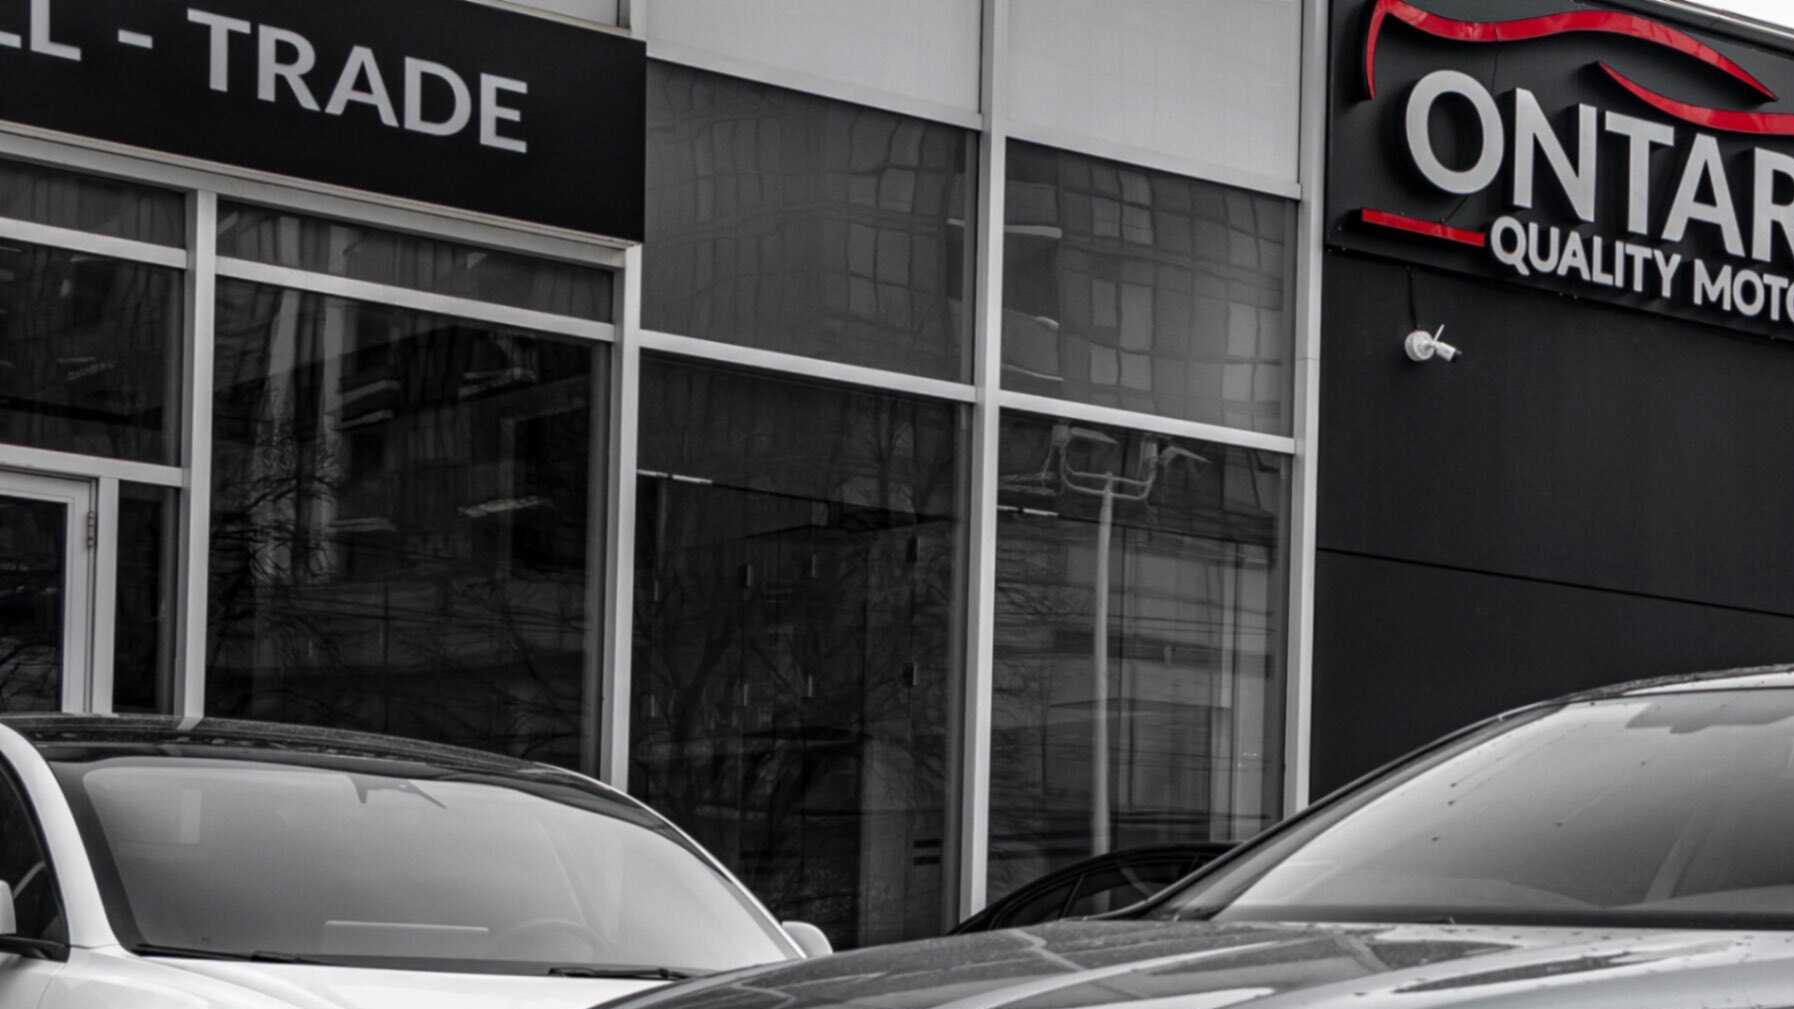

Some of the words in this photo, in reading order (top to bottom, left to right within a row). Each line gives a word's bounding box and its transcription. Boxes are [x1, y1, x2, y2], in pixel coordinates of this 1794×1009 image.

[117, 29, 153, 49] -
[187, 8, 529, 154] TRADE
[1490, 215, 1681, 299] QUALITY
